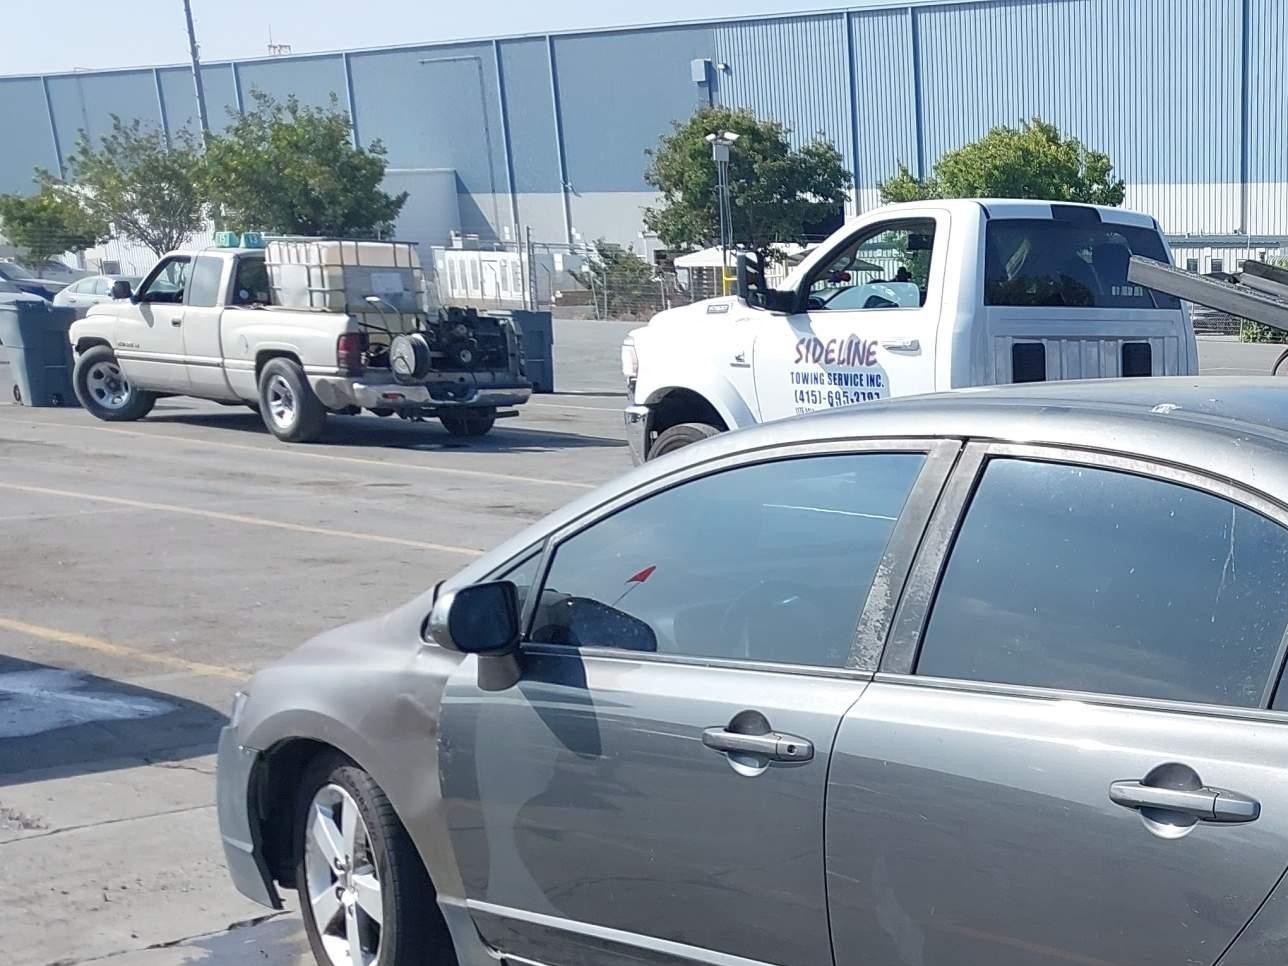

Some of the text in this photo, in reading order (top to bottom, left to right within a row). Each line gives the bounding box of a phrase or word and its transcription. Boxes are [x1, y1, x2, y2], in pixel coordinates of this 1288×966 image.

[794, 337, 878, 367] SIDELINE
[790, 372, 884, 388] TOWING SERVICE INC.
